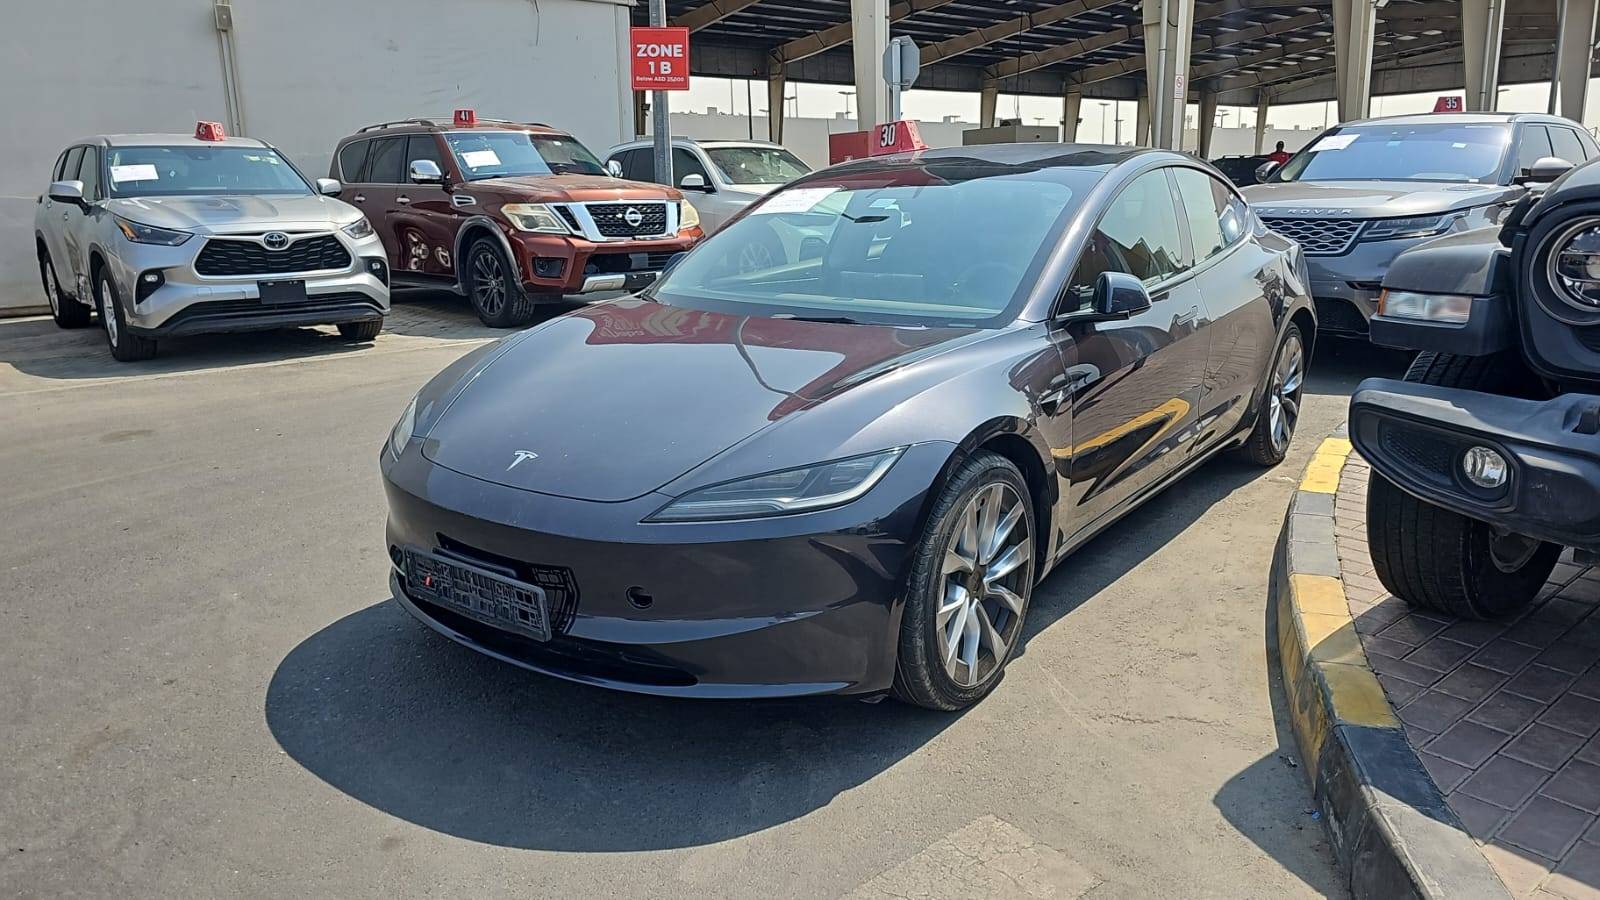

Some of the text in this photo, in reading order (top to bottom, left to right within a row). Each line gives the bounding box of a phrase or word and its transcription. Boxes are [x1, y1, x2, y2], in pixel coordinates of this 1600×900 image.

[636, 44, 683, 57] ZONE
[648, 61, 672, 74] 1 B
[1446, 97, 1457, 109] 35
[460, 110, 469, 121] 41
[880, 124, 896, 147] 30
